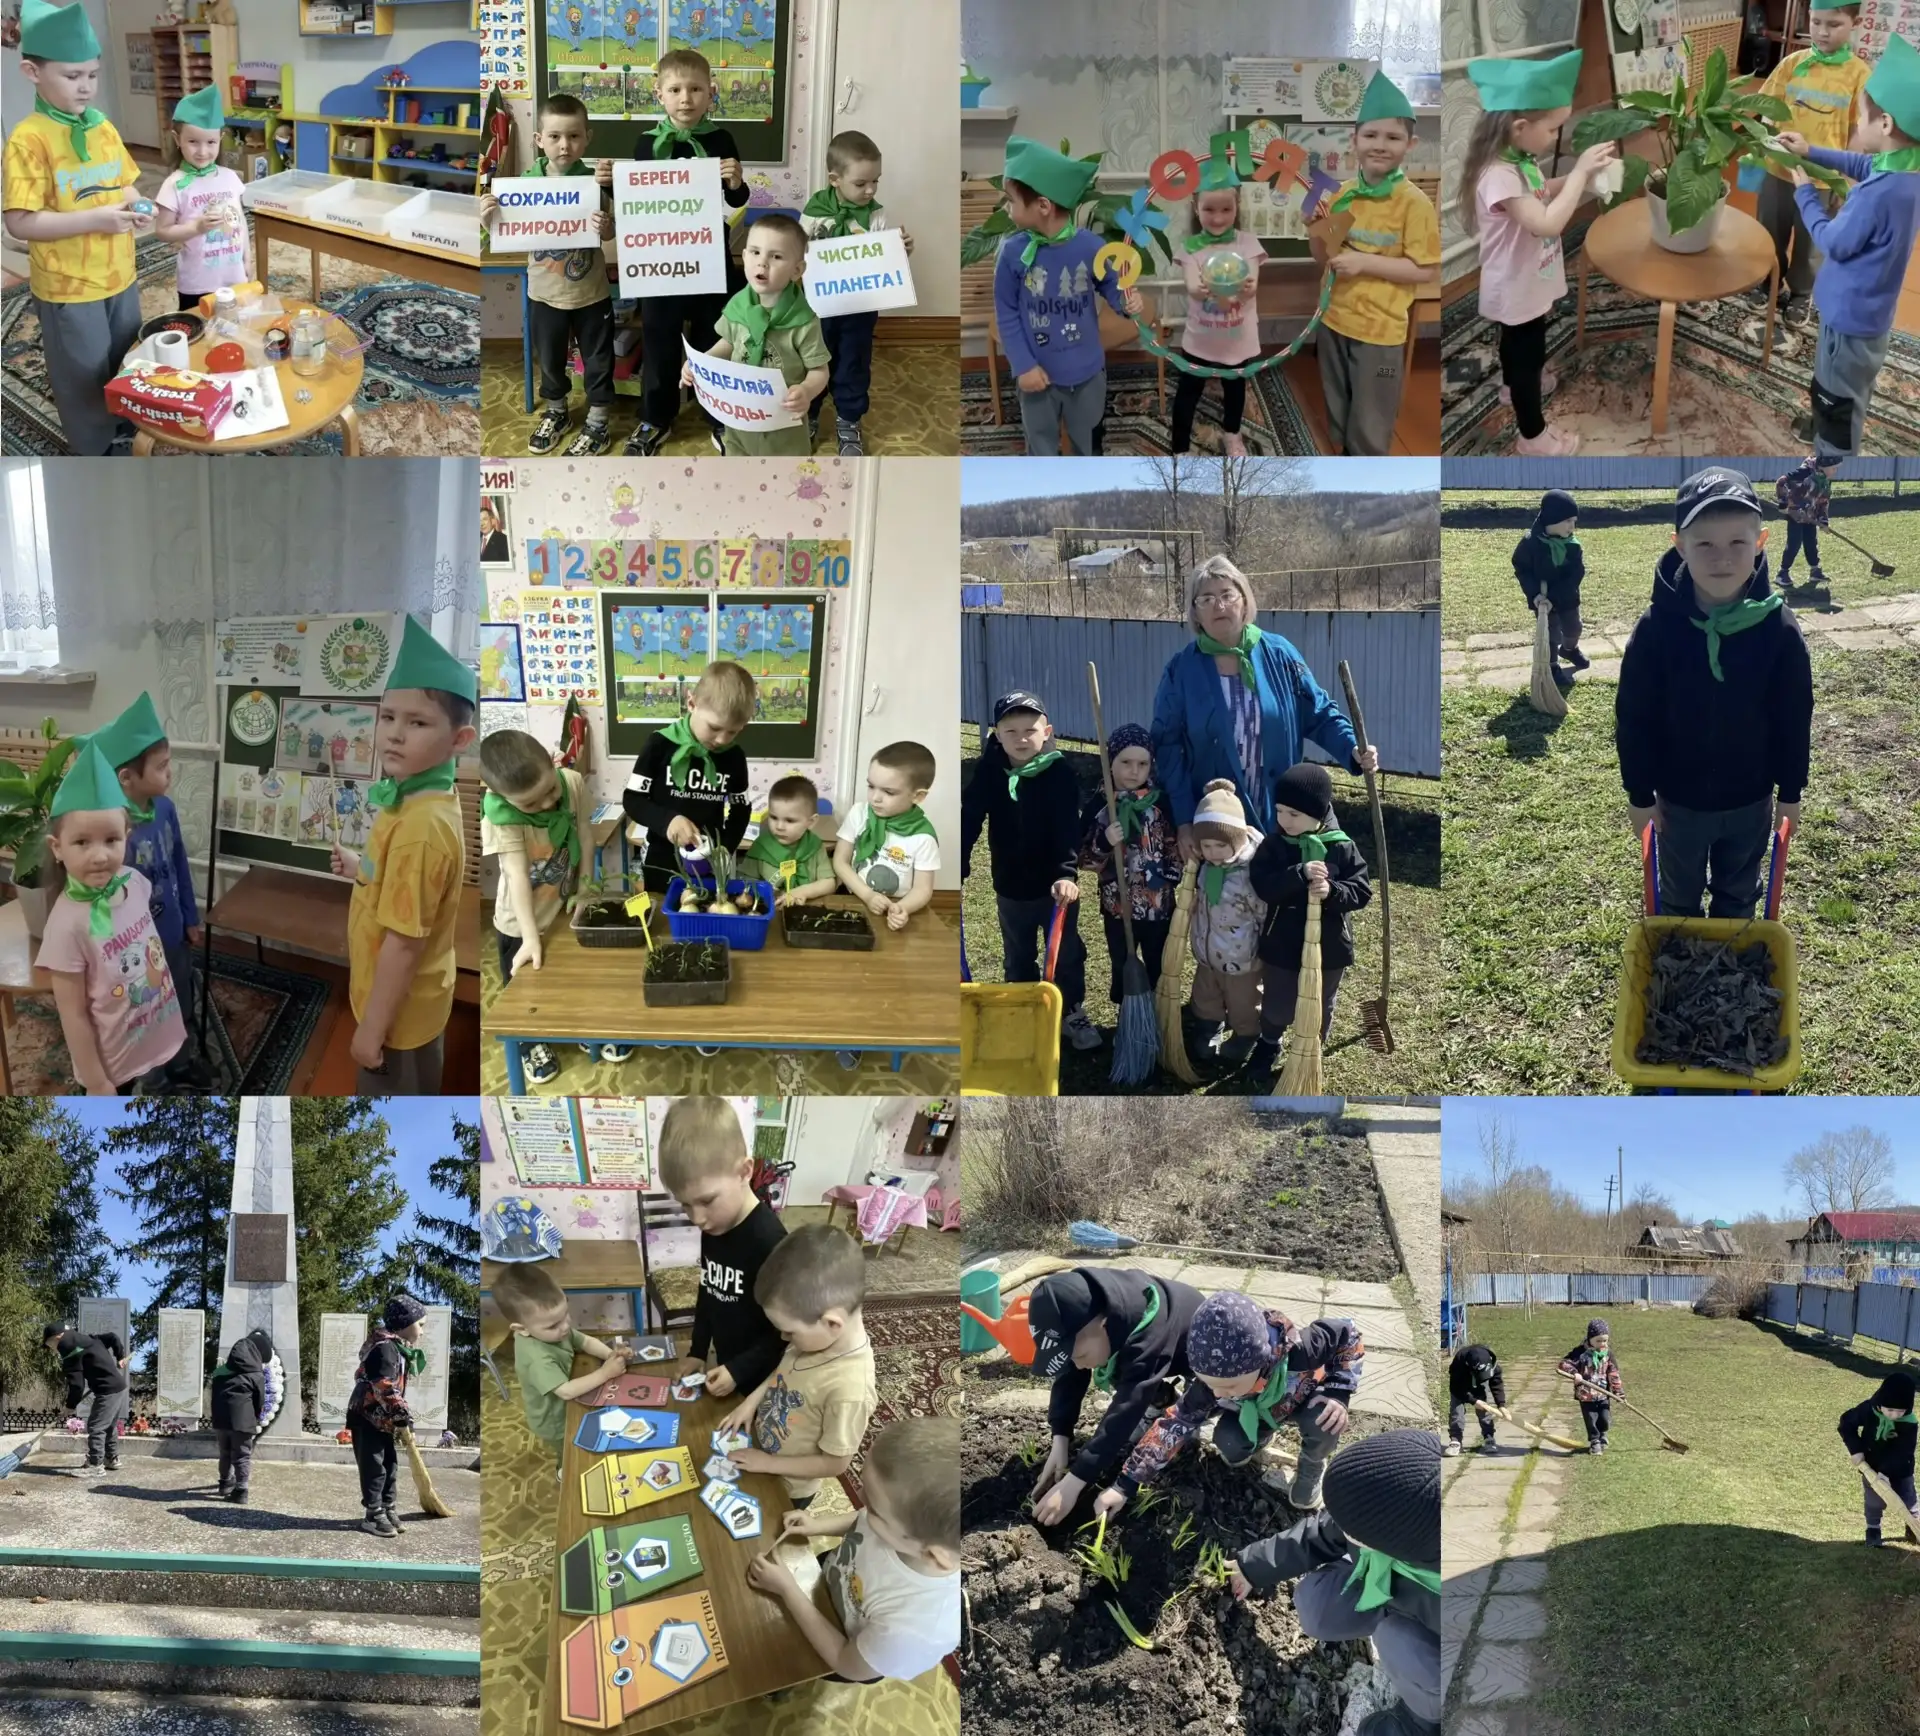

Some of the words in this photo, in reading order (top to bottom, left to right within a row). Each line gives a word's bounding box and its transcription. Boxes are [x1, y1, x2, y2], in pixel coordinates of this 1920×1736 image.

[1866, 1, 1877, 14] 2
[1863, 17, 1874, 30] 3
[494, 29, 504, 40] П
[511, 29, 521, 40] Р
[513, 79, 524, 90] Я
[629, 170, 690, 186] БЕРЕГИ
[499, 191, 580, 207] СОХРАНИ
[622, 199, 704, 216] ПРИРОДУ
[498, 219, 587, 236] ПРИРОДУ!
[411, 231, 459, 248] МЕТАЛЛ
[623, 227, 712, 248] СОРТИРУЙ
[817, 242, 884, 264] ЧИСТАЯ
[626, 261, 700, 278] ОТХОДЫ
[814, 272, 894, 297] ПЛАНЕТА
[1702, 474, 1724, 486] NIKE
[534, 543, 549, 574] 1
[565, 546, 586, 580] 2
[599, 547, 618, 581] 3
[628, 543, 649, 577] 4
[662, 546, 682, 581] 5
[693, 546, 714, 580] 6
[725, 549, 746, 582] 7
[758, 551, 779, 586] 8
[791, 551, 811, 585] 9
[818, 555, 850, 587] 10
[665, 765, 731, 792] ECAPE
[670, 789, 691, 799] FROM
[1045, 1351, 1068, 1376] NIKE
[681, 1523, 699, 1565] СТЕКЛО
[700, 1595, 726, 1662] ПЛАСТИК
